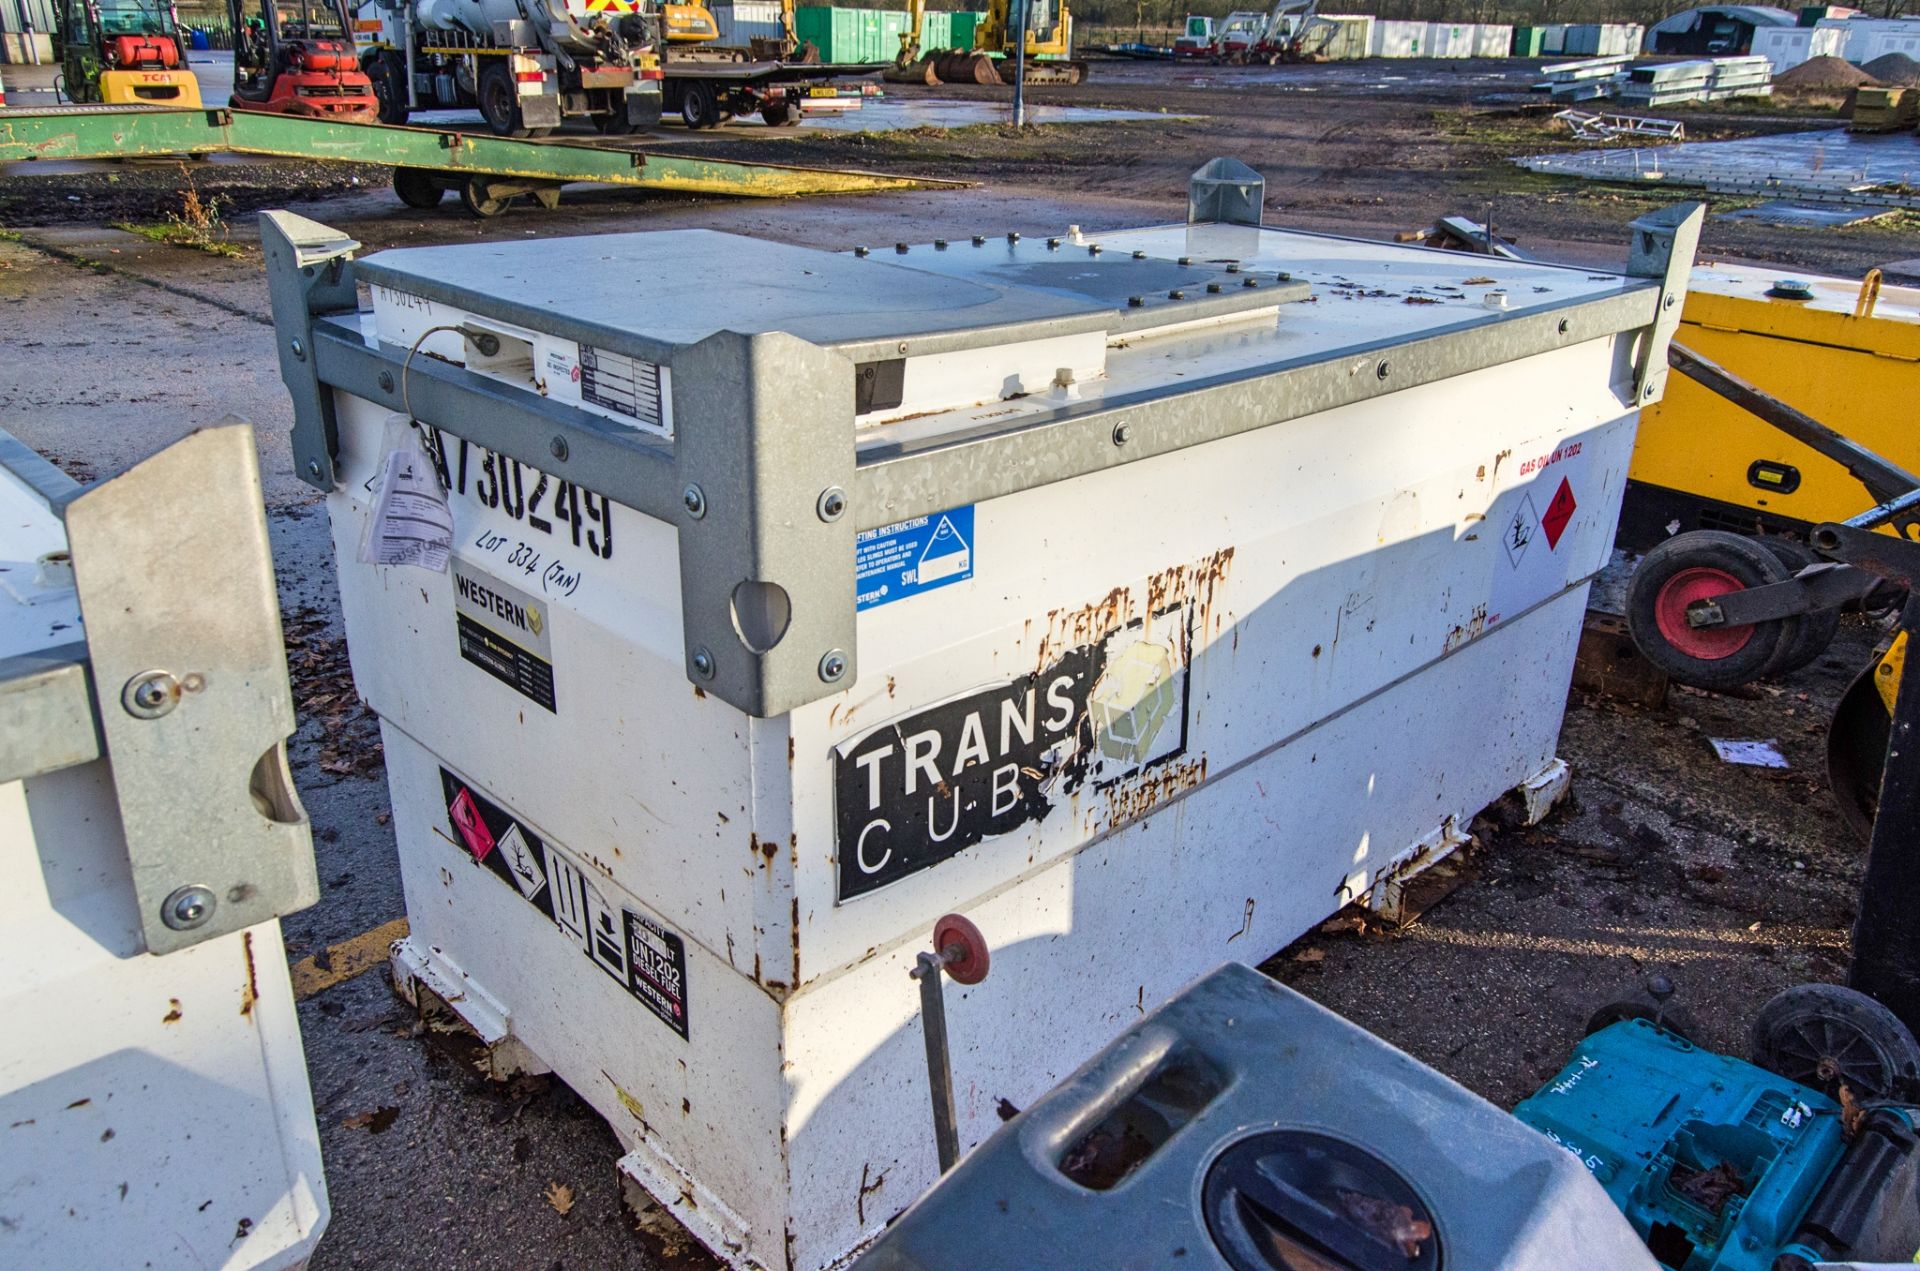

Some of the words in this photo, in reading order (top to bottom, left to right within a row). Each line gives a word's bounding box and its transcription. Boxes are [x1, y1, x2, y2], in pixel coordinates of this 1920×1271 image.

[142, 73, 171, 82] TCM
[1519, 458, 1536, 476] GAS
[1537, 453, 1549, 470] OIL
[1564, 442, 1582, 459] 1202
[879, 516, 929, 536] INSTRUCTIONS
[876, 539, 897, 550] CAUTION
[475, 529, 507, 552] LOT
[507, 542, 540, 576] 334
[543, 560, 581, 597] (JAN)
[902, 568, 918, 585] SWL
[456, 573, 526, 631] WESTERN
[857, 589, 881, 604] STERN
[856, 675, 1075, 811] TRANS
[632, 953, 659, 983] DIESEL
[661, 976, 681, 1000] FUEL
[634, 975, 673, 1013] WESTERN
